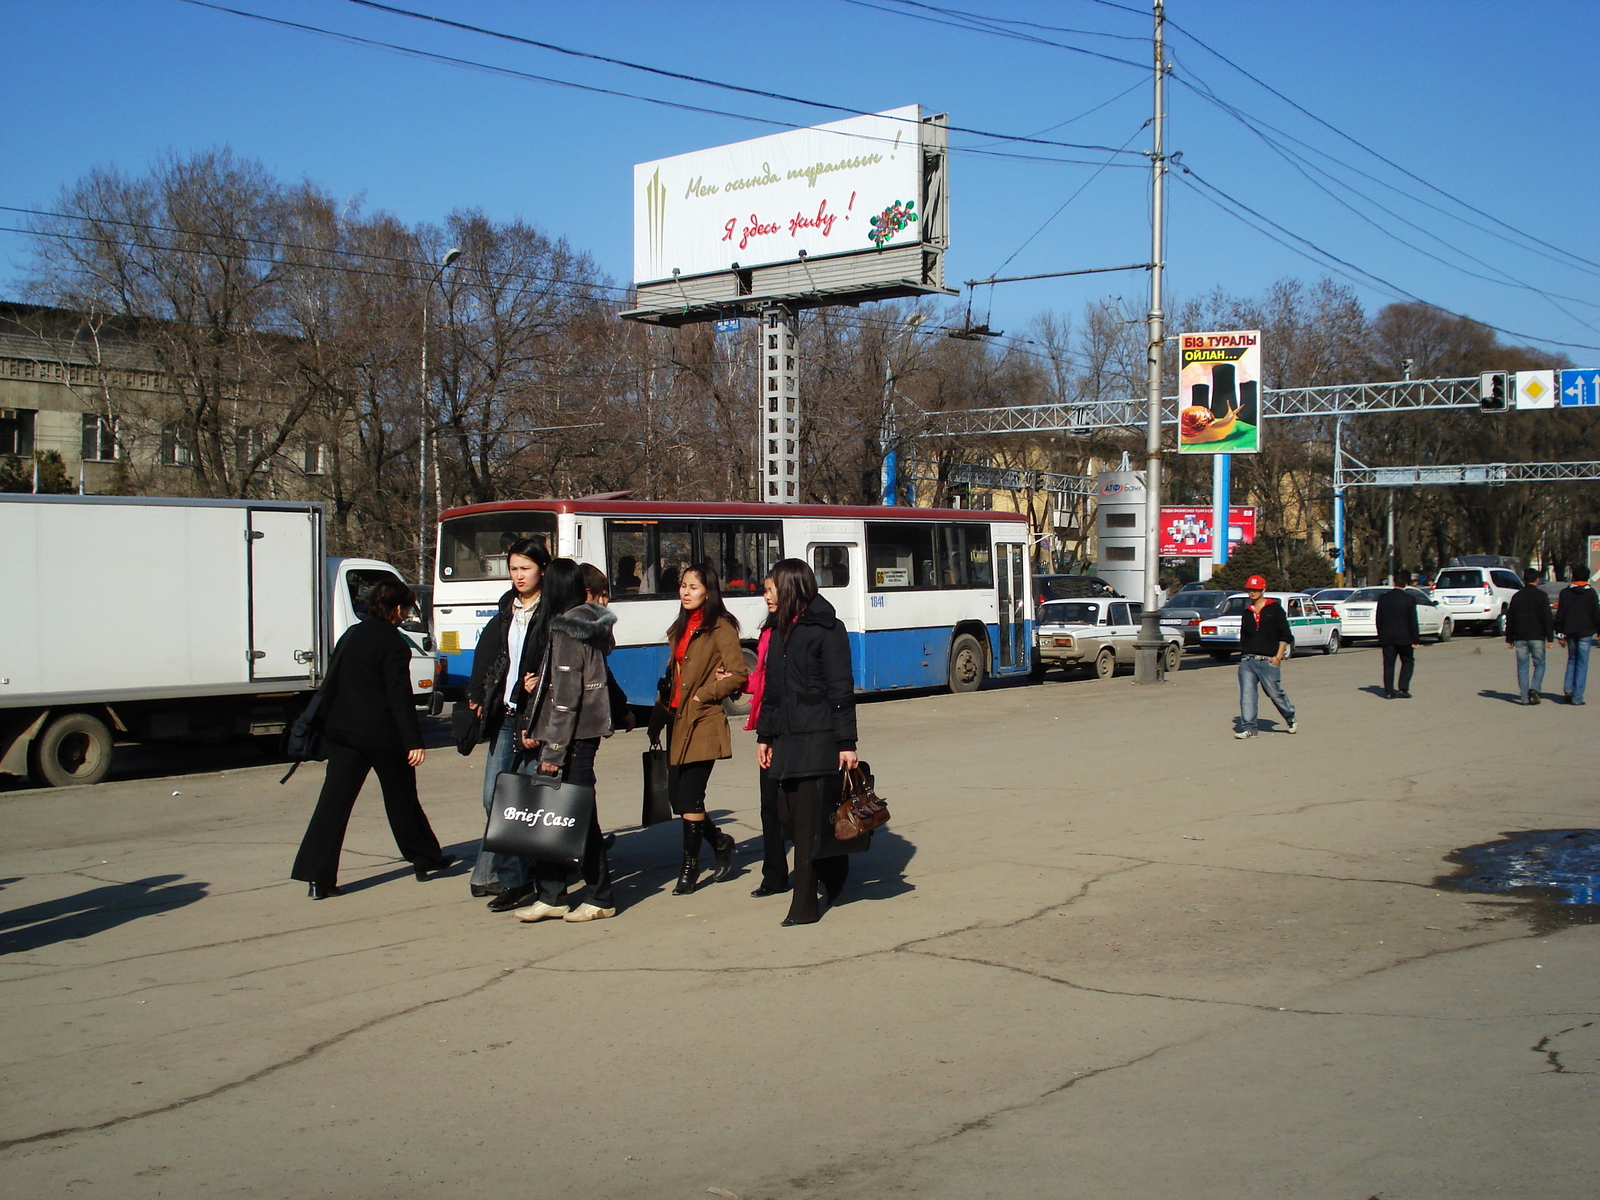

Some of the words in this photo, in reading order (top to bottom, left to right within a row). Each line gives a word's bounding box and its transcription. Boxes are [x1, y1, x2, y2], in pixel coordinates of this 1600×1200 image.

[684, 174, 720, 200] Мен
[724, 161, 782, 193] осында
[721, 216, 738, 242] Я
[738, 213, 782, 250] здесь
[788, 198, 838, 238] живу
[1207, 335, 1257, 347] ТУРАЛЫ
[870, 595, 885, 608] 1841
[503, 806, 545, 827] Brief
[543, 811, 576, 828] Case
